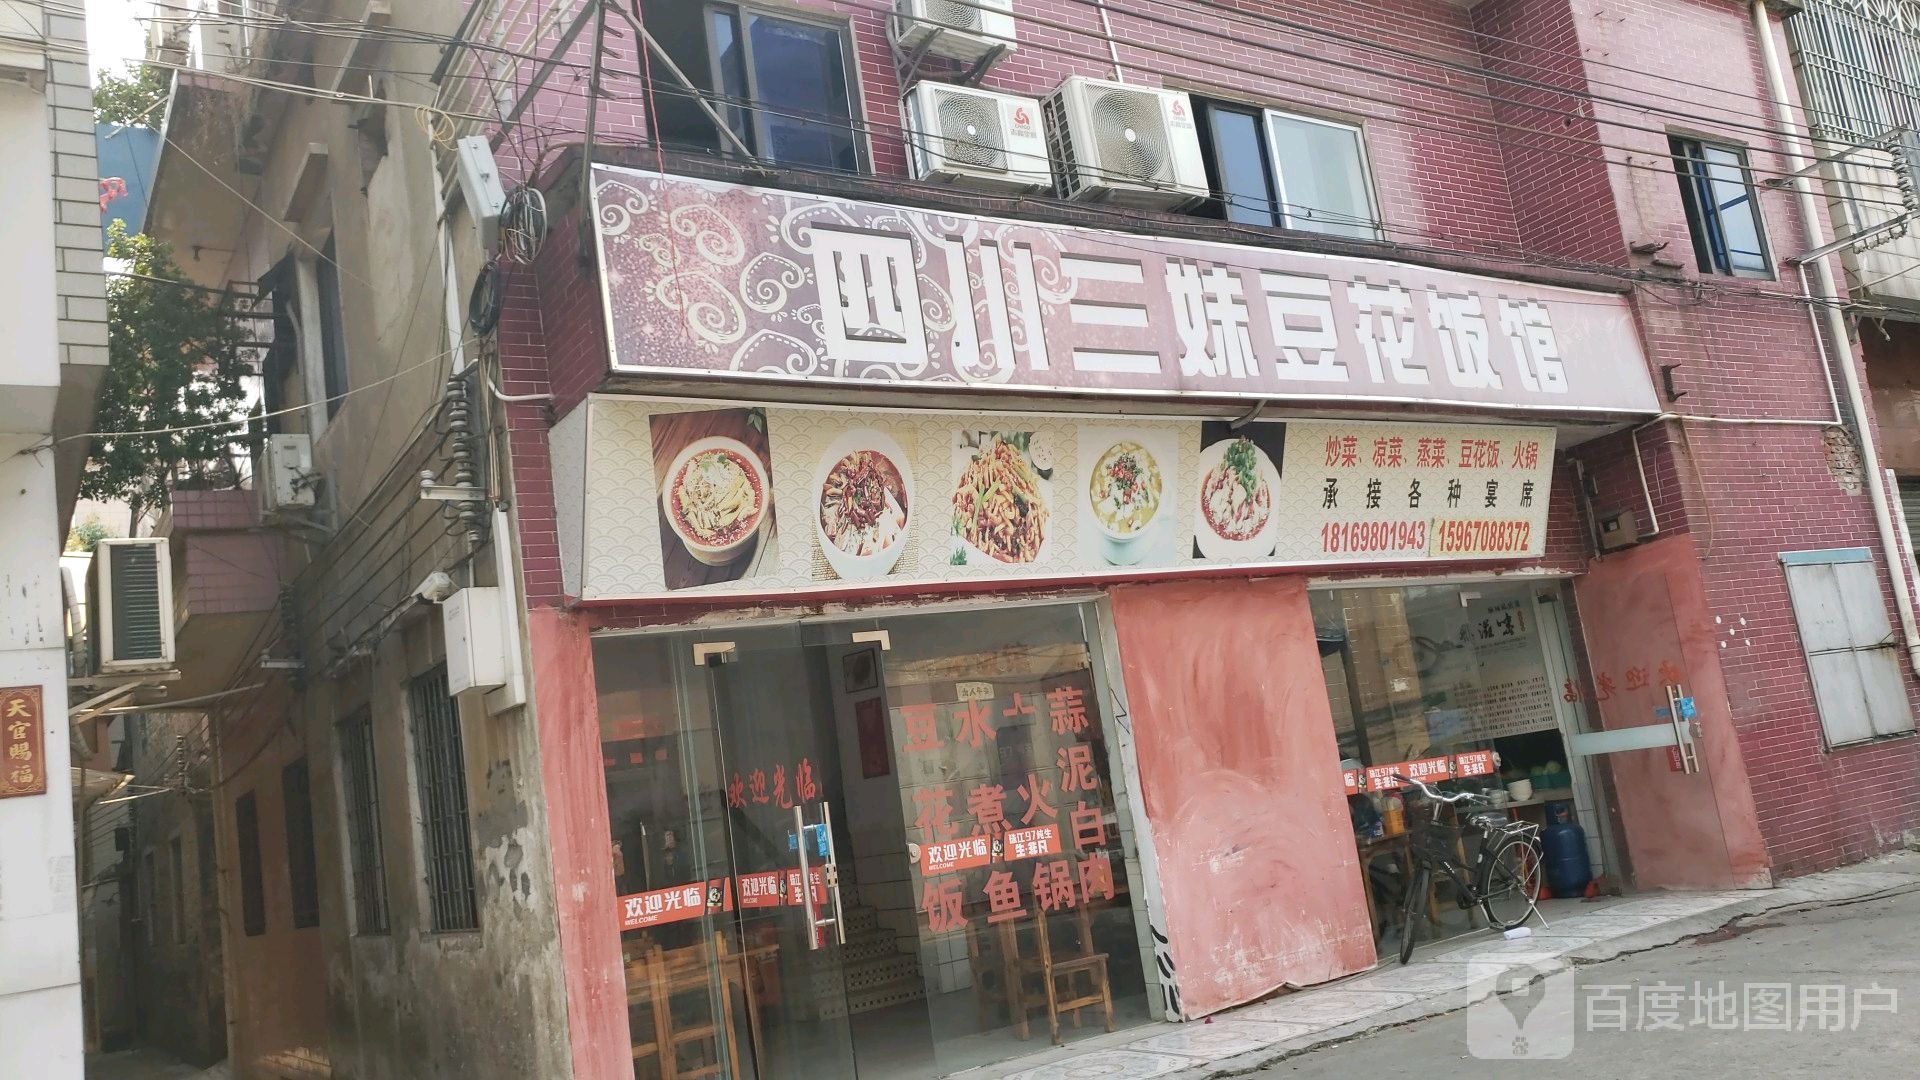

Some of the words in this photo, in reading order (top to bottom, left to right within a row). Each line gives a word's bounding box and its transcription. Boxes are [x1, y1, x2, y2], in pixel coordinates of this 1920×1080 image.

[810, 225, 1569, 394] 四川三妹豆花饭馆
[1322, 477, 1534, 509] 承接各种宴席
[1321, 520, 1426, 552] 18169801943
[1439, 520, 1531, 552] 15967088372
[1409, 760, 1447, 777] 欢迎光临
[952, 698, 1028, 924] 水煮鱼
[1046, 686, 1115, 905] 蒜泥白肉
[900, 703, 968, 932] 豆花饭
[928, 839, 988, 864] 欢迎光临
[928, 862, 955, 871] WELCOME
[742, 876, 778, 897] 欢迎光临
[624, 887, 702, 919] 欢迎光临
[624, 915, 659, 926] WELCOME
